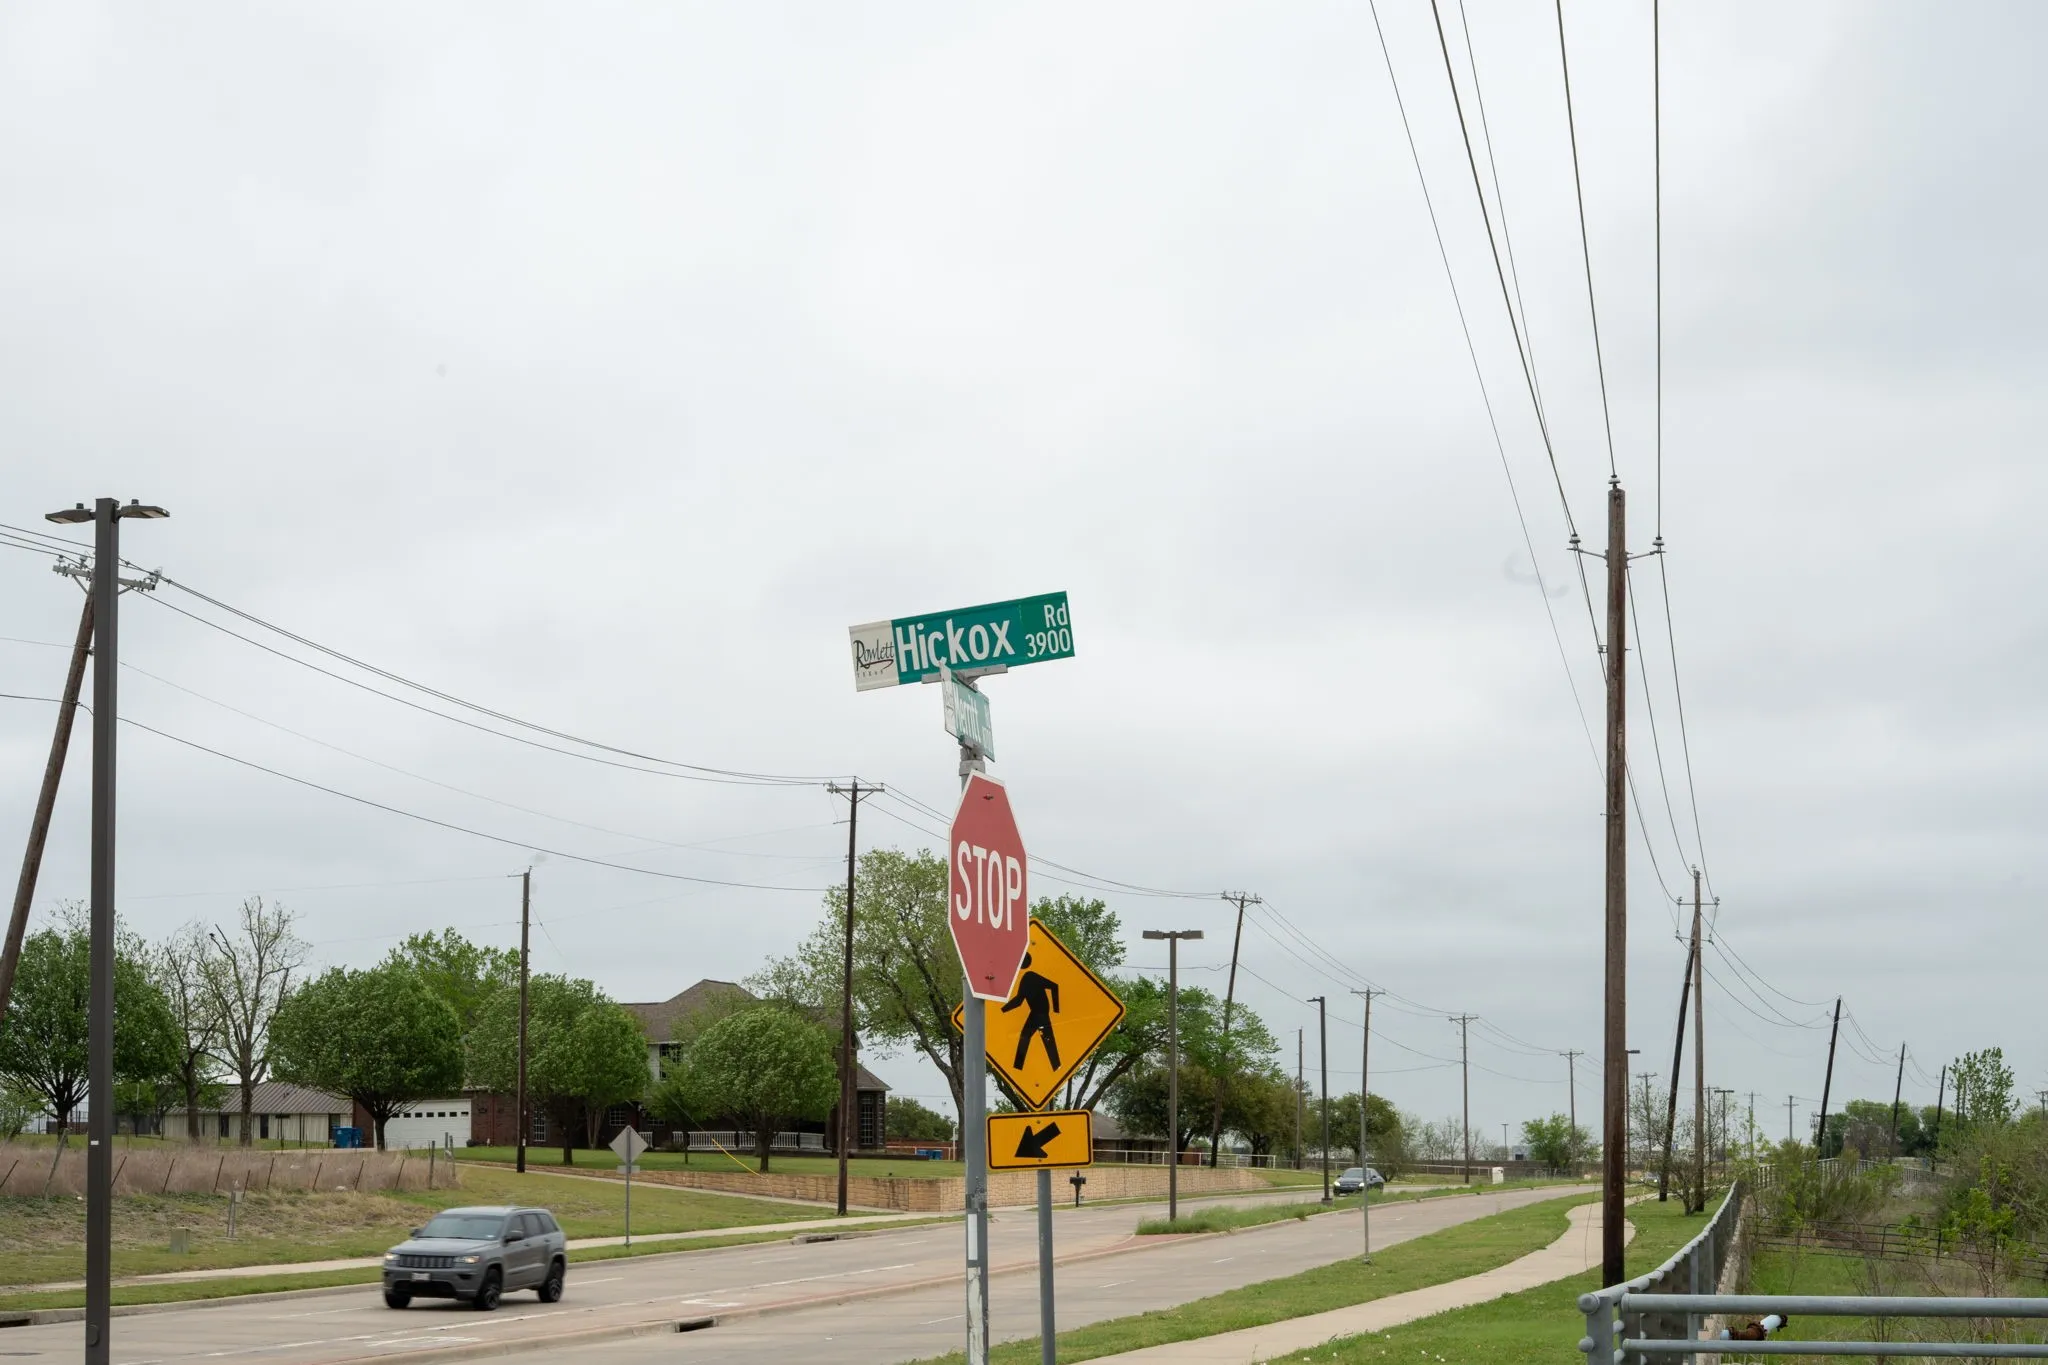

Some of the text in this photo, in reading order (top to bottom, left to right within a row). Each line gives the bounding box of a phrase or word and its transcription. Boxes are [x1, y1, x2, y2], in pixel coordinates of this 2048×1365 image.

[853, 638, 894, 671] Rowlett
[896, 602, 1068, 672] Hickox Rd
[1025, 628, 1071, 658] 3900
[956, 840, 1022, 931] STOP
